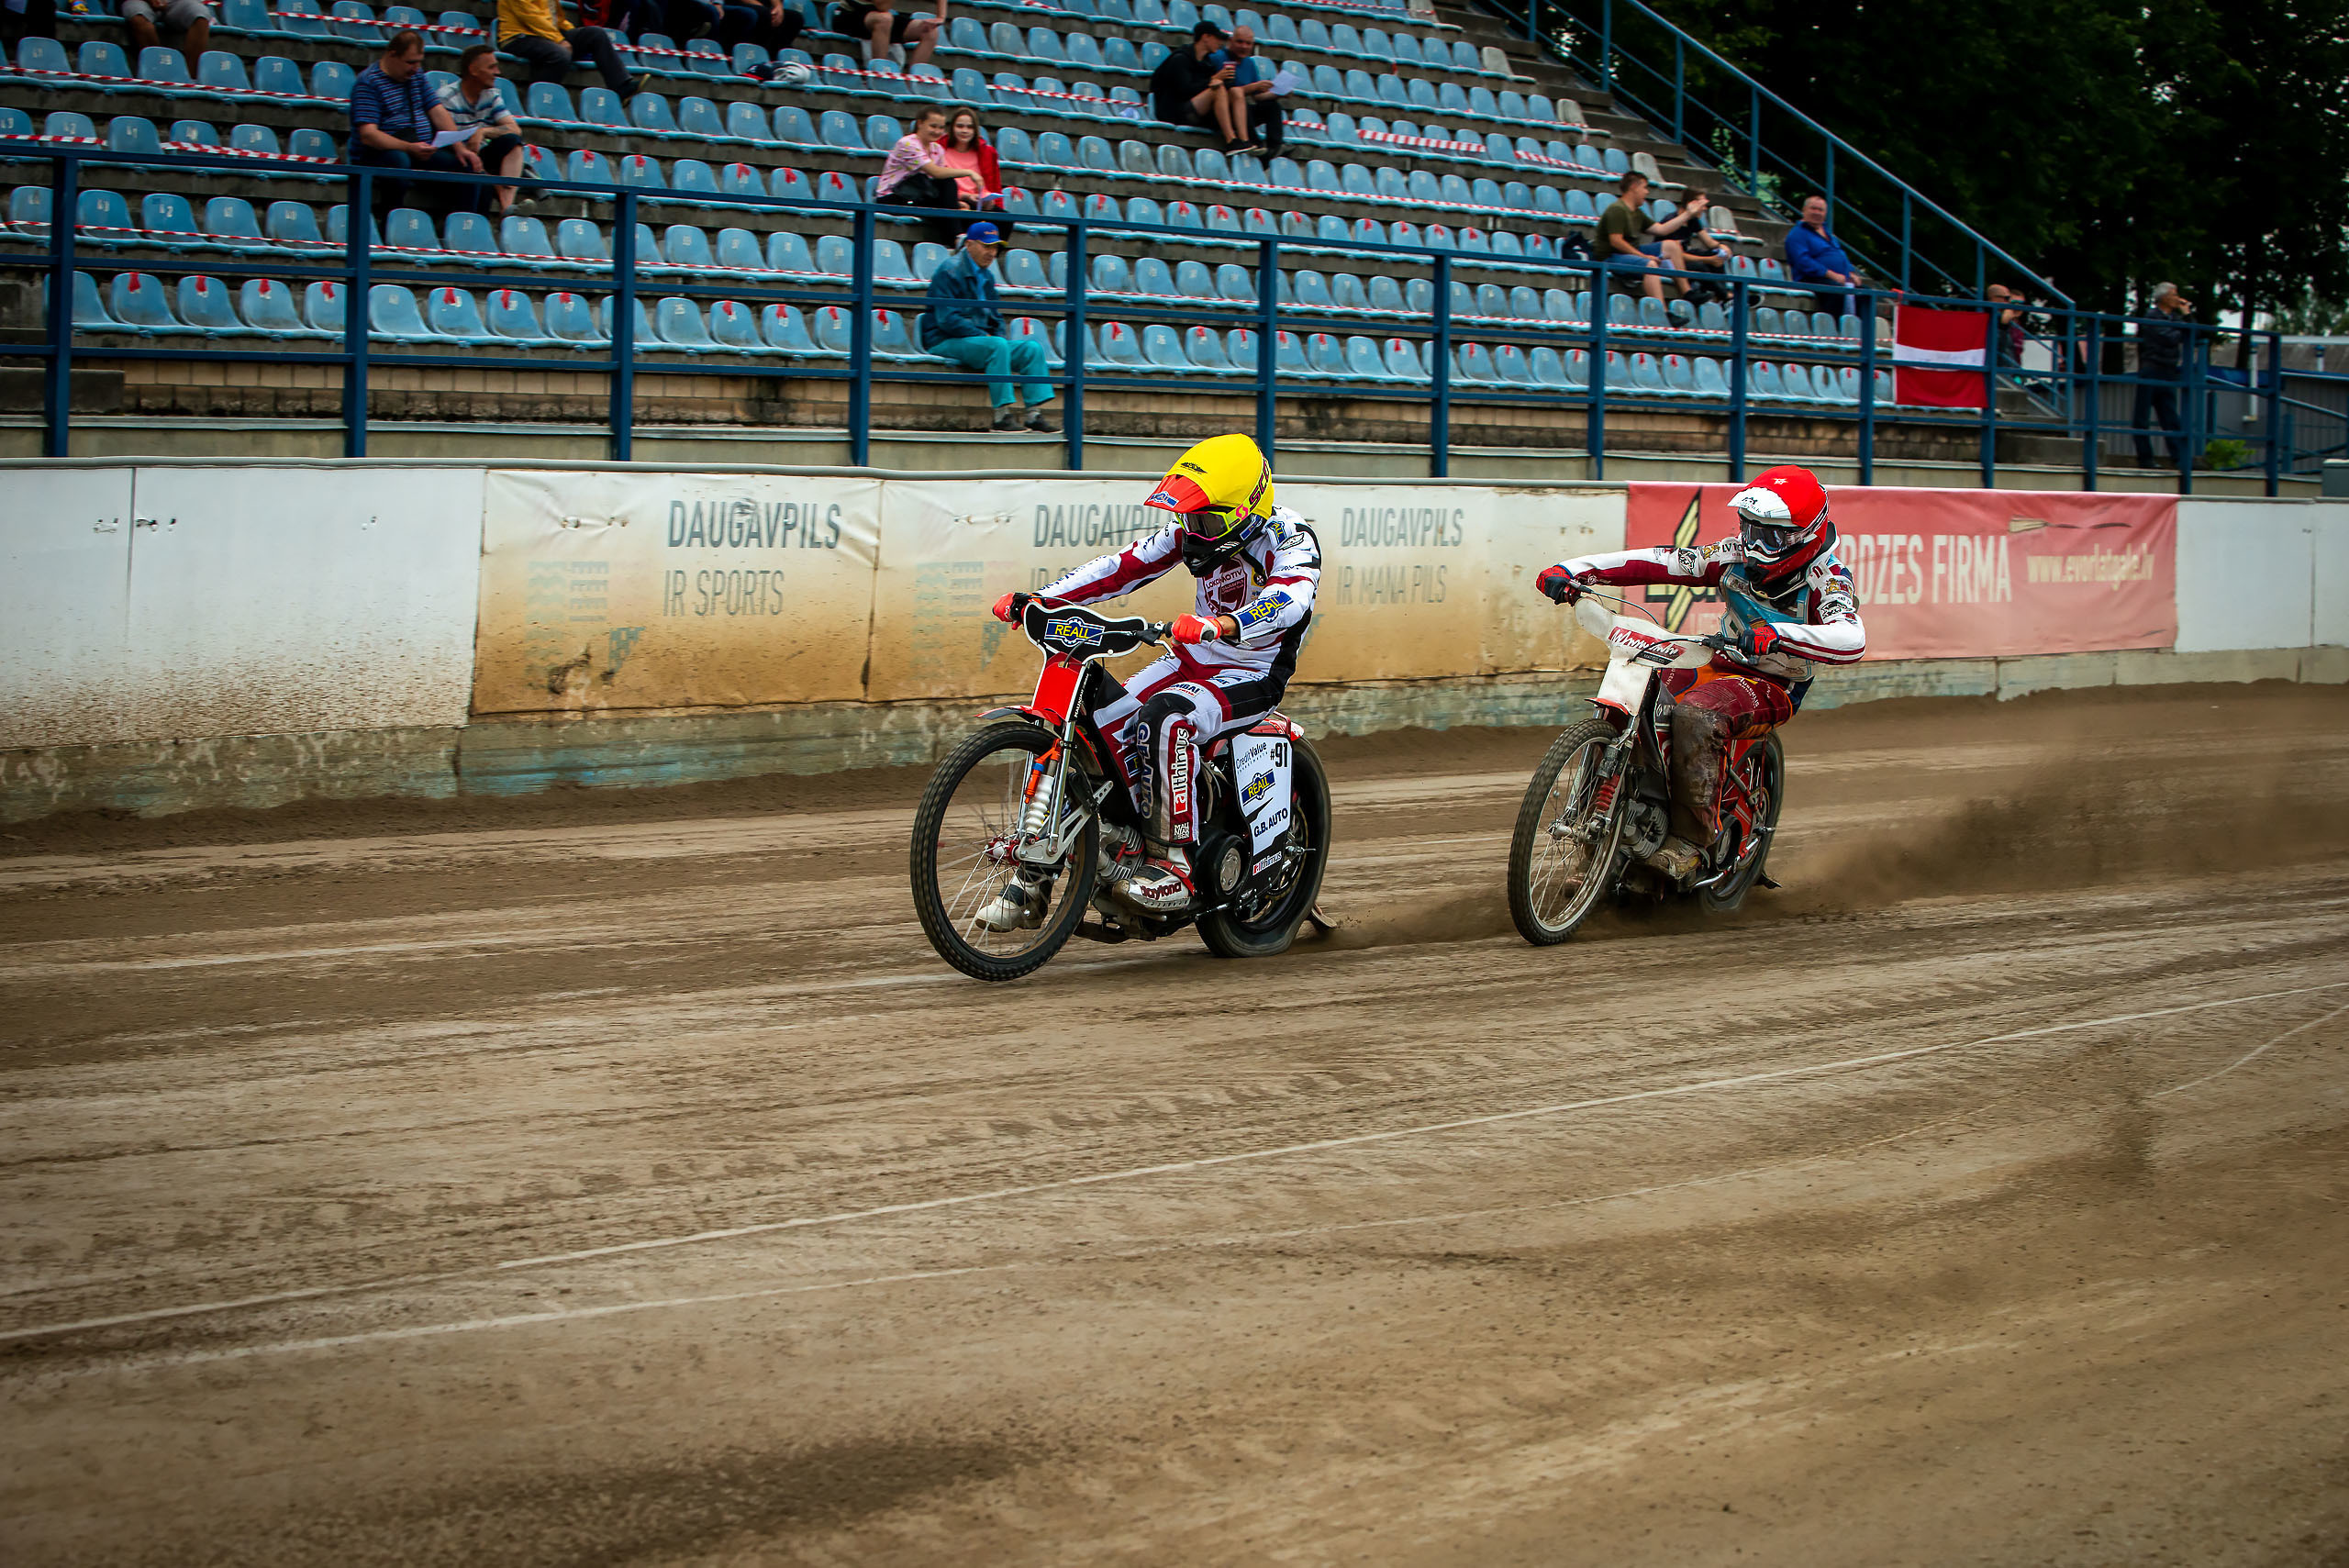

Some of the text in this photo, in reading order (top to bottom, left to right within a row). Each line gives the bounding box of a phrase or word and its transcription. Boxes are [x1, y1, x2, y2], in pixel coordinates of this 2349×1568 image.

[667, 499, 841, 550] DAUGAVPILS
[1033, 503, 1170, 548] DAUGAVPI
[1340, 506, 1464, 548] DAUGAVPILS
[1335, 564, 1354, 606] IR
[1410, 563, 1448, 605] PILS
[1932, 533, 2012, 605] FIRMA
[662, 569, 785, 617] IR SPORTS
[1248, 596, 1285, 621] REALL
[1054, 624, 1089, 639] REALL
[1171, 727, 1189, 814] althimus
[1270, 741, 1288, 768] #91
[1248, 775, 1270, 798] REALL
[1253, 807, 1288, 837] G.B. AUTO
[1140, 881, 1182, 900] daytona
